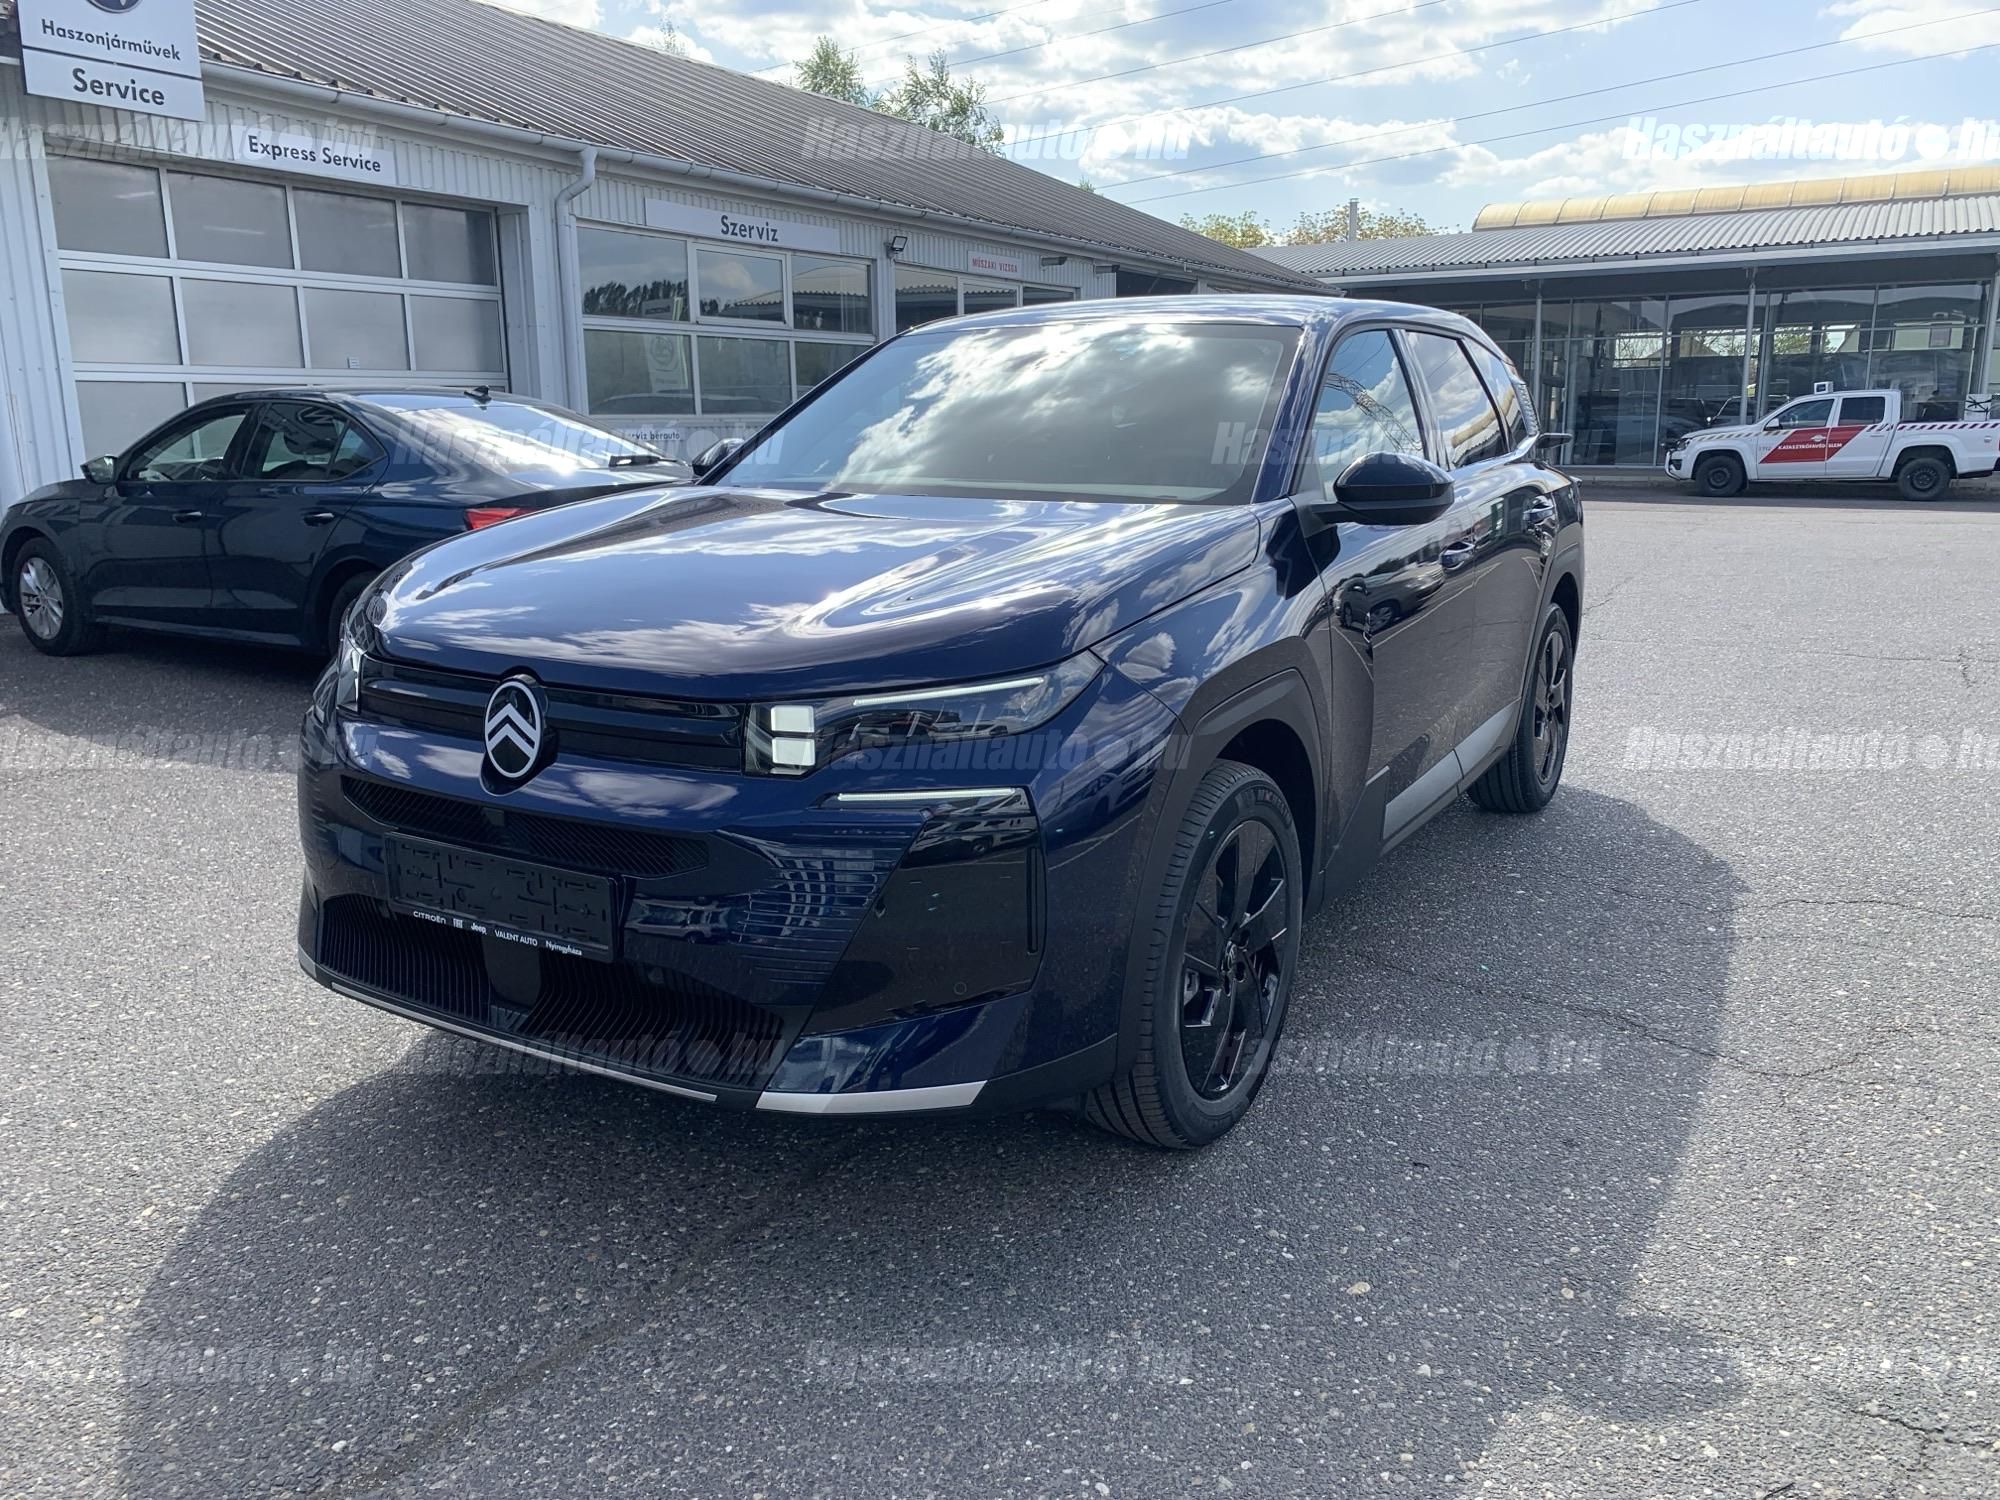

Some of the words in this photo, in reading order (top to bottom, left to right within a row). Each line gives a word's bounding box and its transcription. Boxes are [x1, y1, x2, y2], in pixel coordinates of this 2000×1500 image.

[41, 18, 181, 61] Haszonjárművek
[72, 67, 165, 106] Service
[248, 134, 317, 162] Express
[322, 147, 381, 172] Service
[720, 214, 778, 242] Szerviz
[494, 929, 519, 943] VALENT
[519, 936, 538, 947] AUTO
